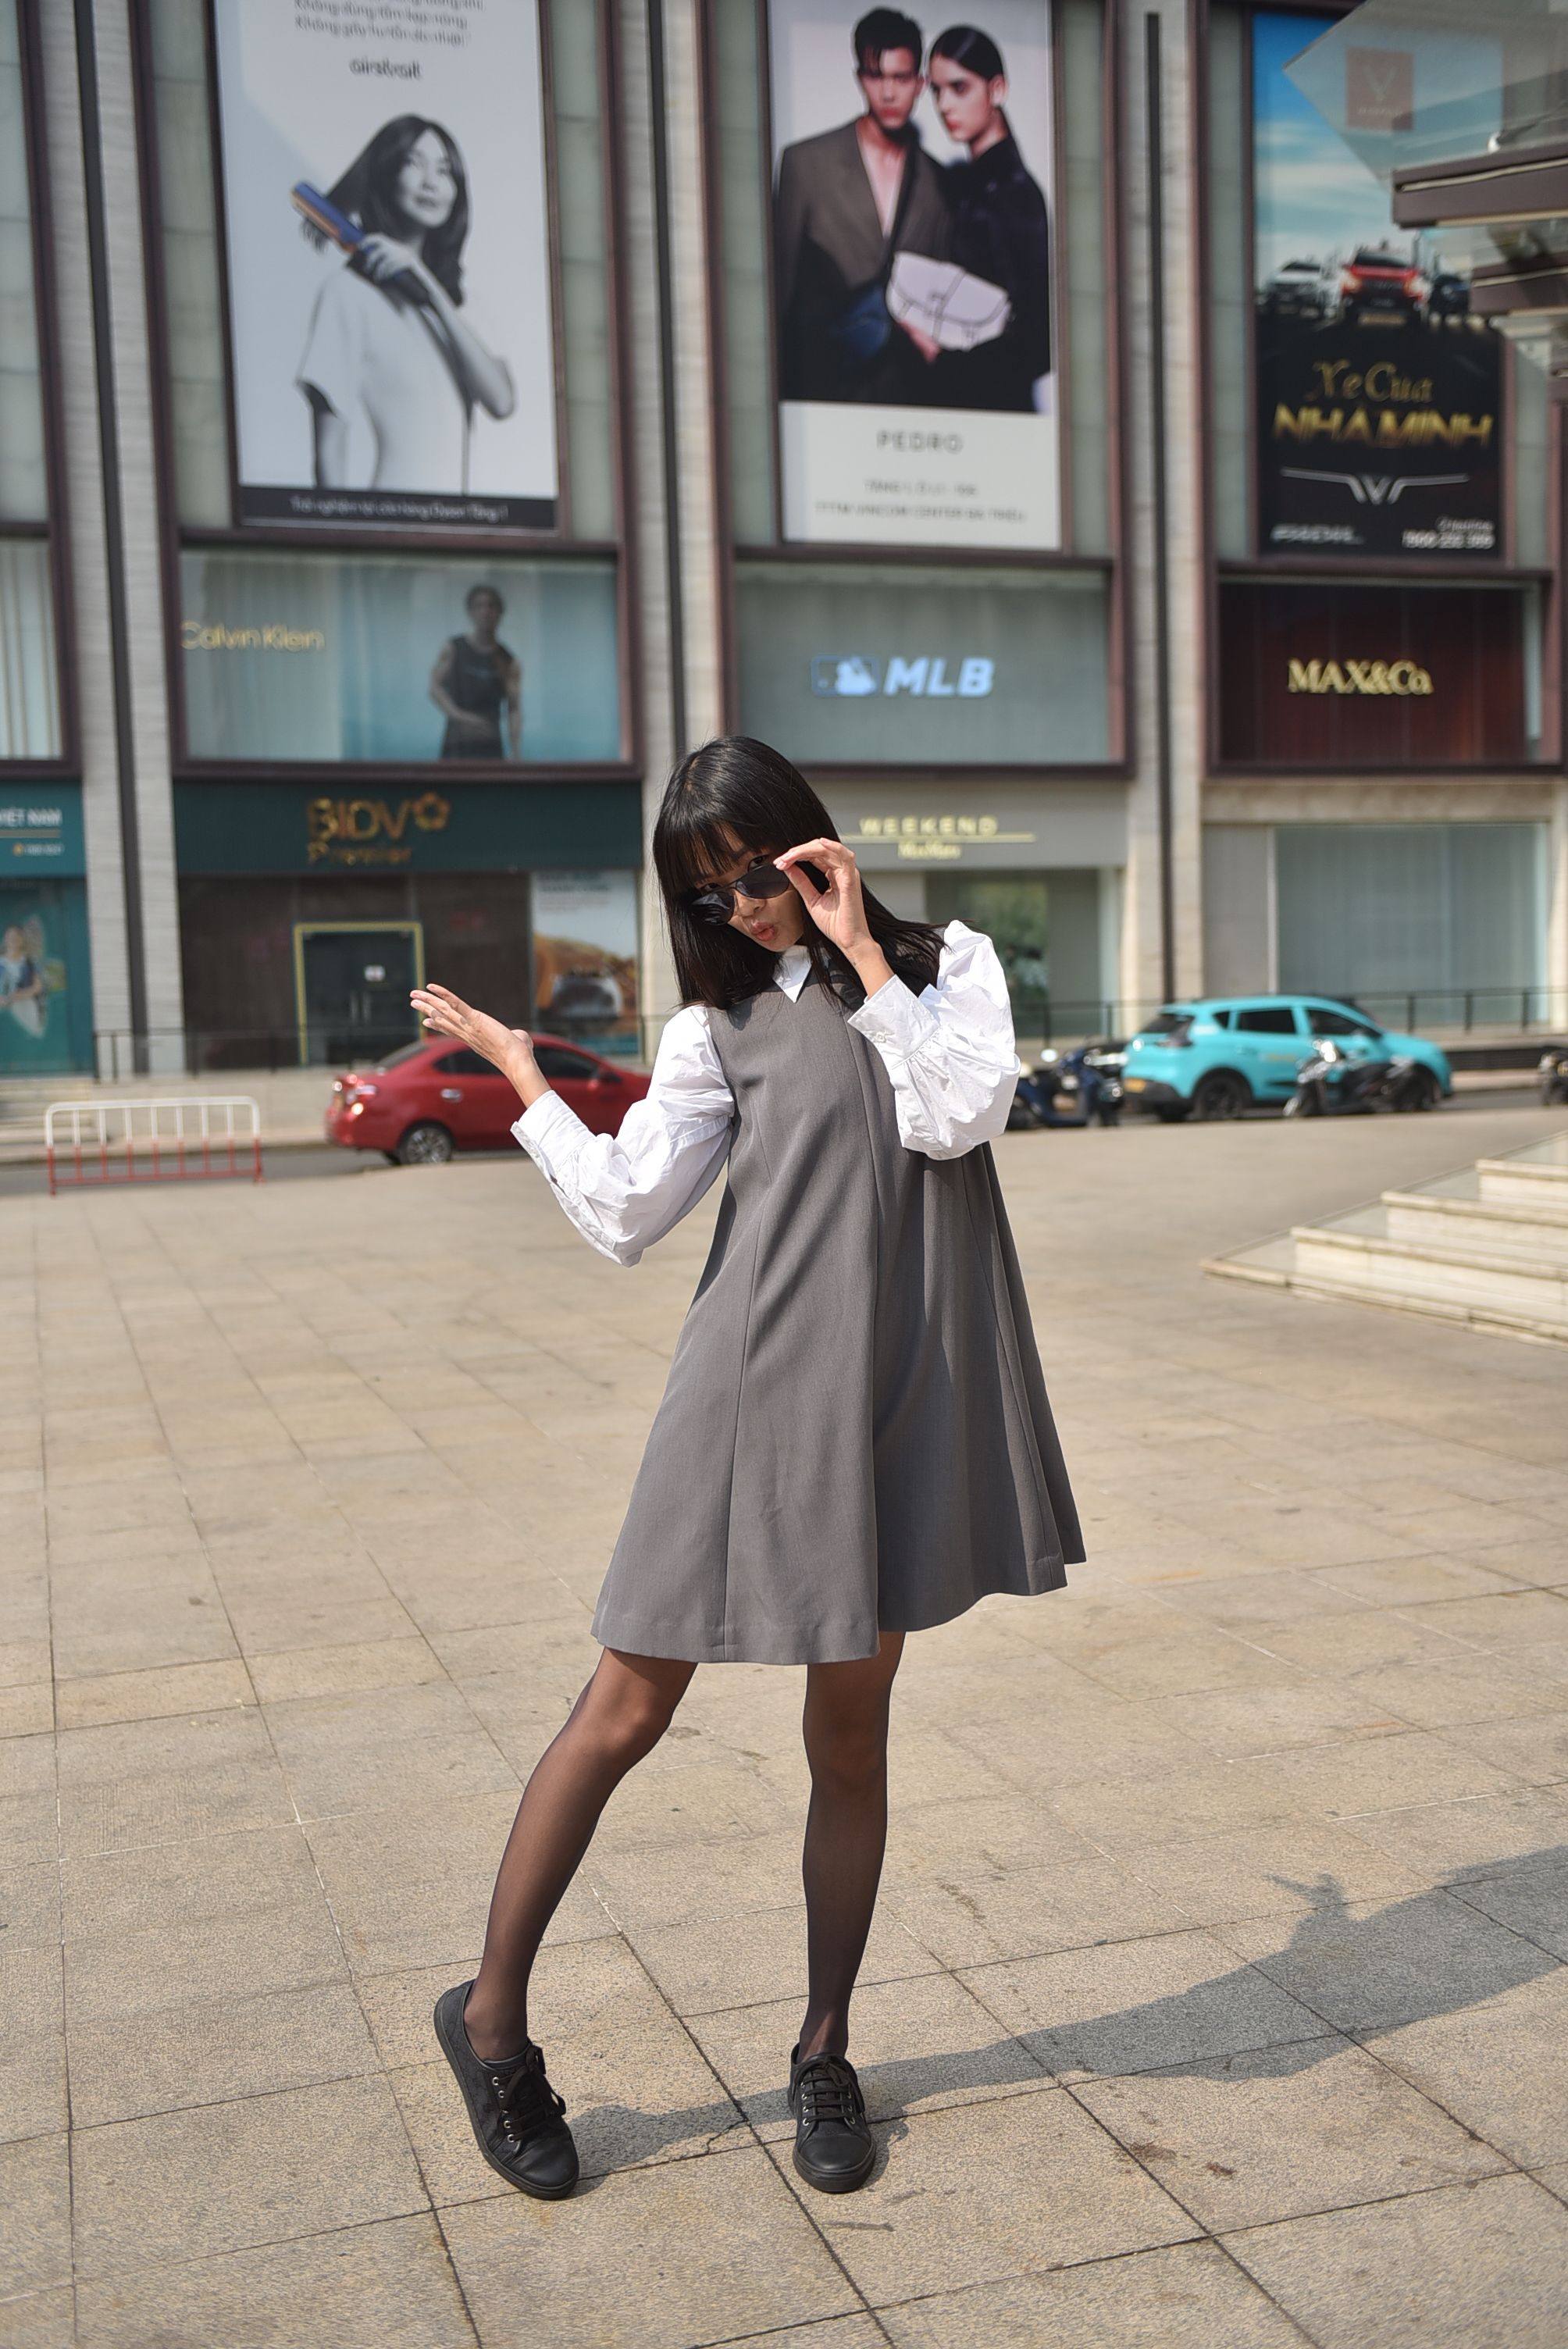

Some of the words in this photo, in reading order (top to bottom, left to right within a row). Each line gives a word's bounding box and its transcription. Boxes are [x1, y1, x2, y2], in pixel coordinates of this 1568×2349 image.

[875, 430, 964, 454] PEDRO
[181, 621, 262, 651] Calvin
[263, 623, 326, 652] Klein
[883, 657, 995, 697] MLB
[308, 798, 412, 841] BIDV
[860, 816, 998, 836] WEEKEND
